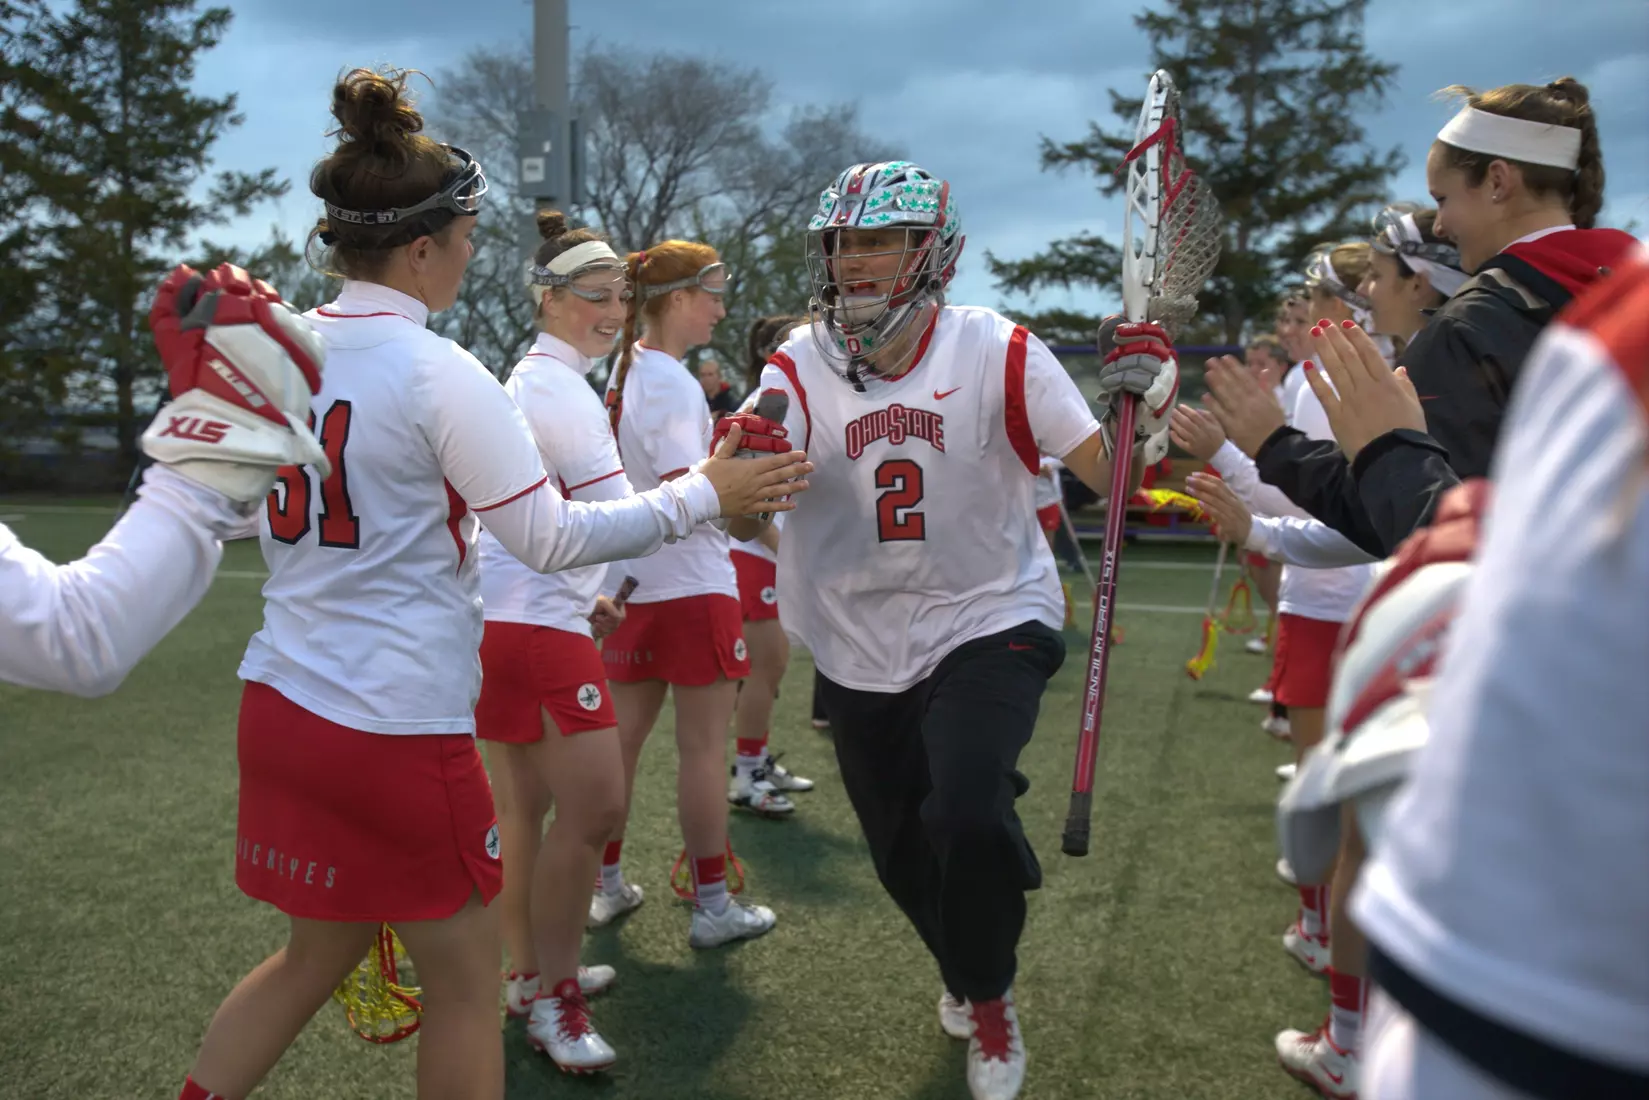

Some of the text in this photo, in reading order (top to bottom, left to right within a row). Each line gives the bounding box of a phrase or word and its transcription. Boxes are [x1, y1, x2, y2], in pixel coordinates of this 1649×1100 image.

[158, 416, 233, 444] STX
[875, 459, 926, 543] 2
[1096, 595, 1108, 633] PRO
[1103, 551, 1114, 578] STX
